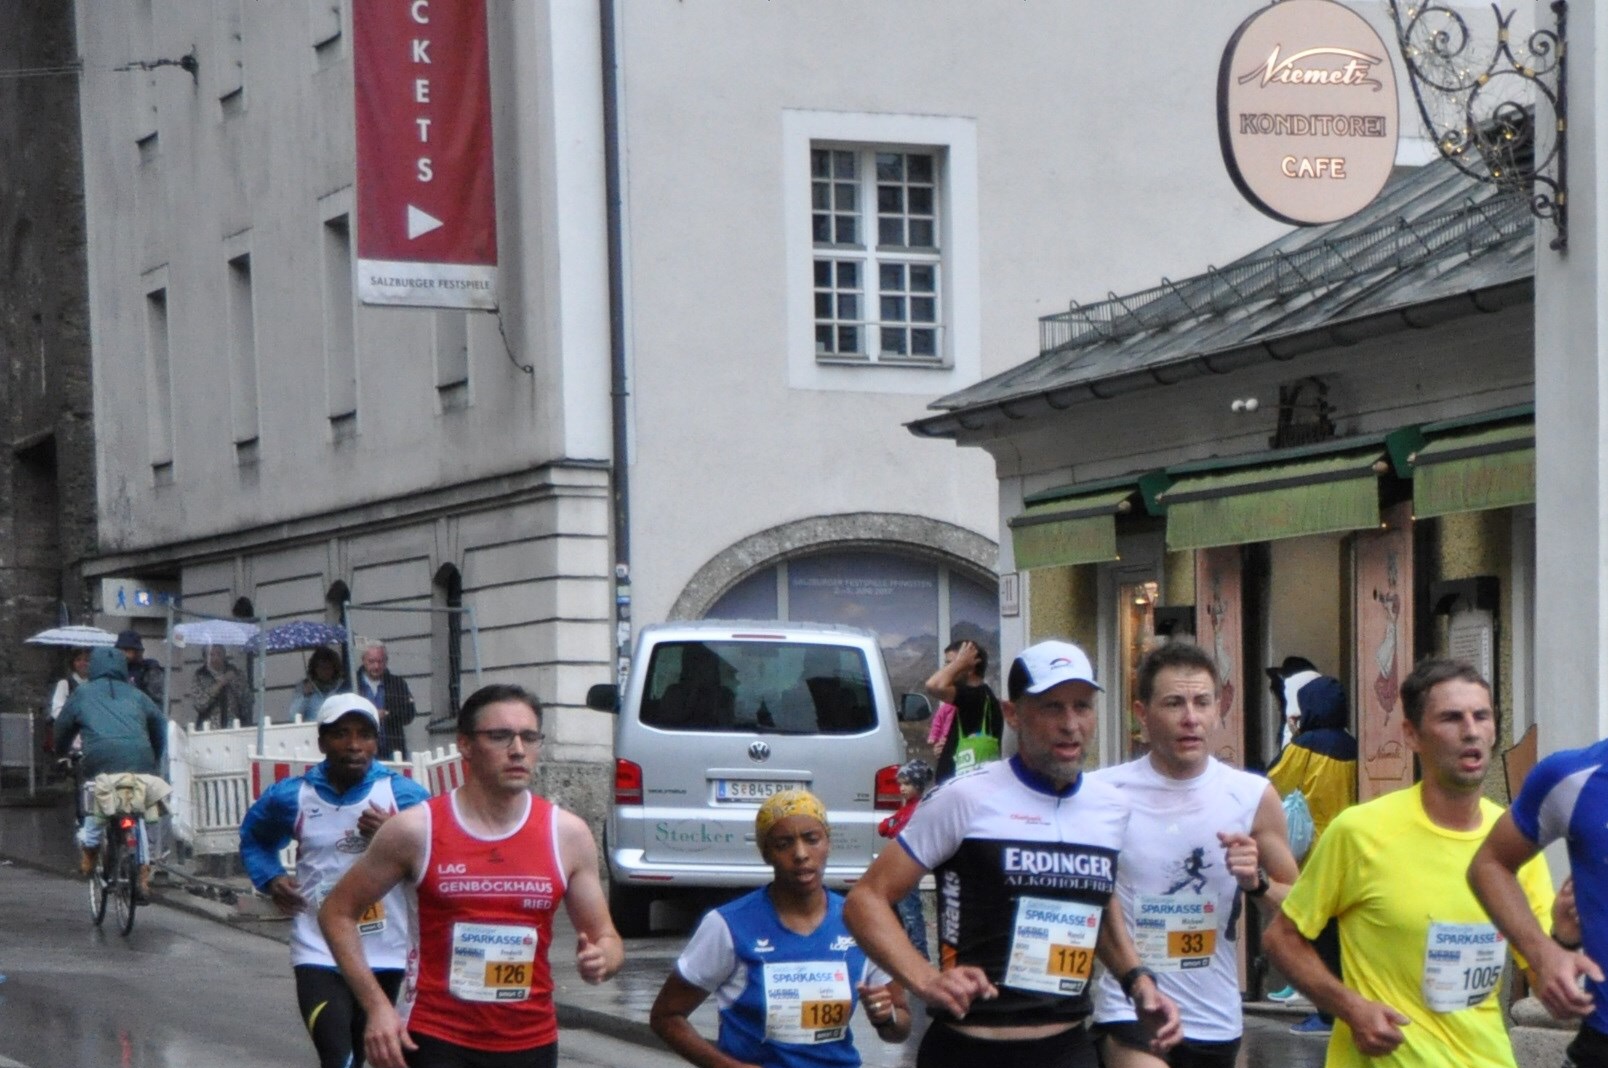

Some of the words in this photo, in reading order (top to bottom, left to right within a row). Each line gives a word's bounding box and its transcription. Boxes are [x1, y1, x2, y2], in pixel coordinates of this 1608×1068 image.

[1238, 43, 1383, 92] Niemetz
[1240, 113, 1386, 137] KONDITOREI
[1281, 154, 1346, 178] CAFE
[370, 276, 435, 289] SALZBURGER
[438, 280, 490, 290] FESTSPIELE
[655, 820, 734, 843] Stocker
[438, 864, 466, 874] LAG
[1005, 847, 1113, 881] ERDINGER
[438, 879, 553, 894] GENBÖCKHAUS
[523, 899, 552, 910] RIED
[1141, 904, 1203, 914] SPARKASSE
[1025, 909, 1087, 928] SPARKASSE
[461, 933, 523, 946] SPARKASSE
[1181, 933, 1204, 954] 33
[1436, 933, 1495, 944] SPARKASSE
[1058, 948, 1088, 974] 112
[494, 964, 525, 985] 126
[773, 972, 833, 984] SPARKASSE
[1463, 965, 1501, 991] 1005
[811, 1002, 844, 1026] 183
